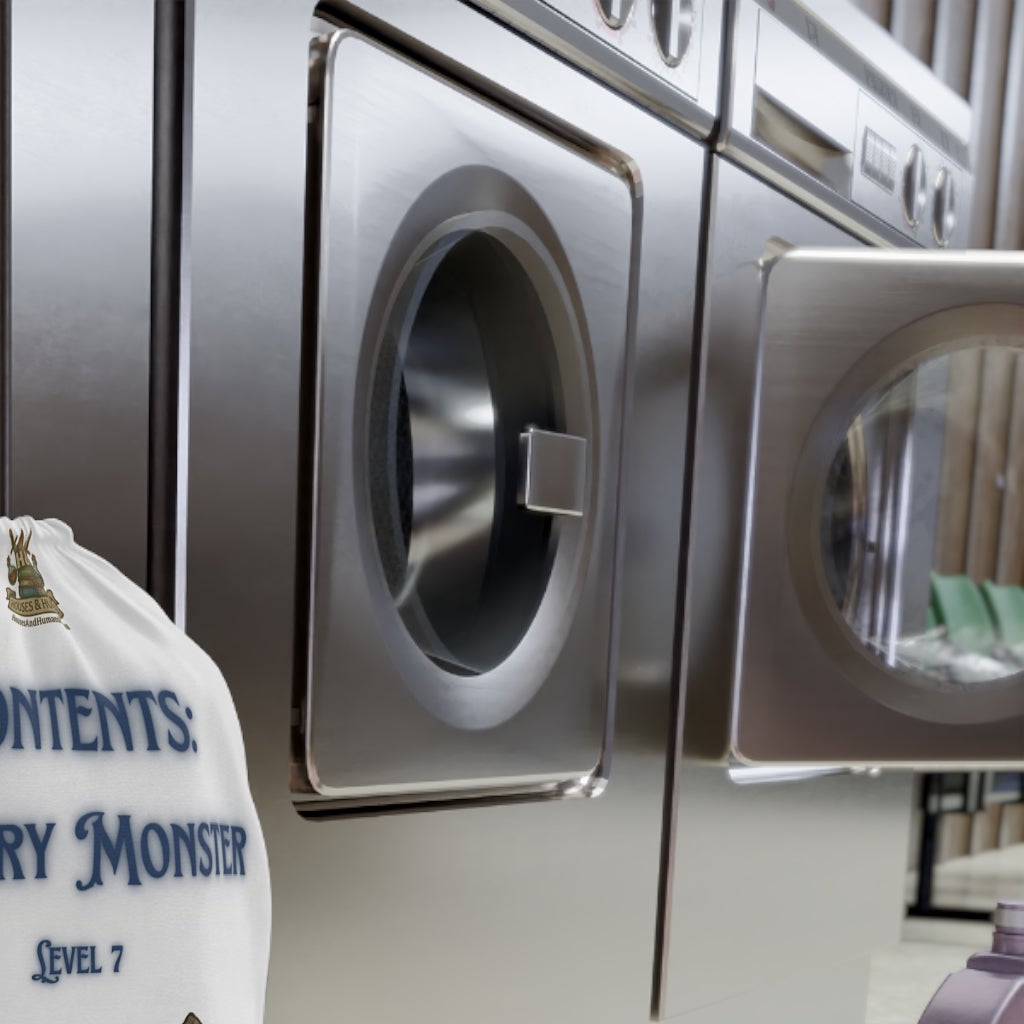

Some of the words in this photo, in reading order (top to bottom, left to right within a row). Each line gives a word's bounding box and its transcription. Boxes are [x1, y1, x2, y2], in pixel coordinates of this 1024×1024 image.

[75, 811, 247, 891] MONSTER
[32, 939, 102, 984] LEVEL
[110, 944, 124, 973] 7
